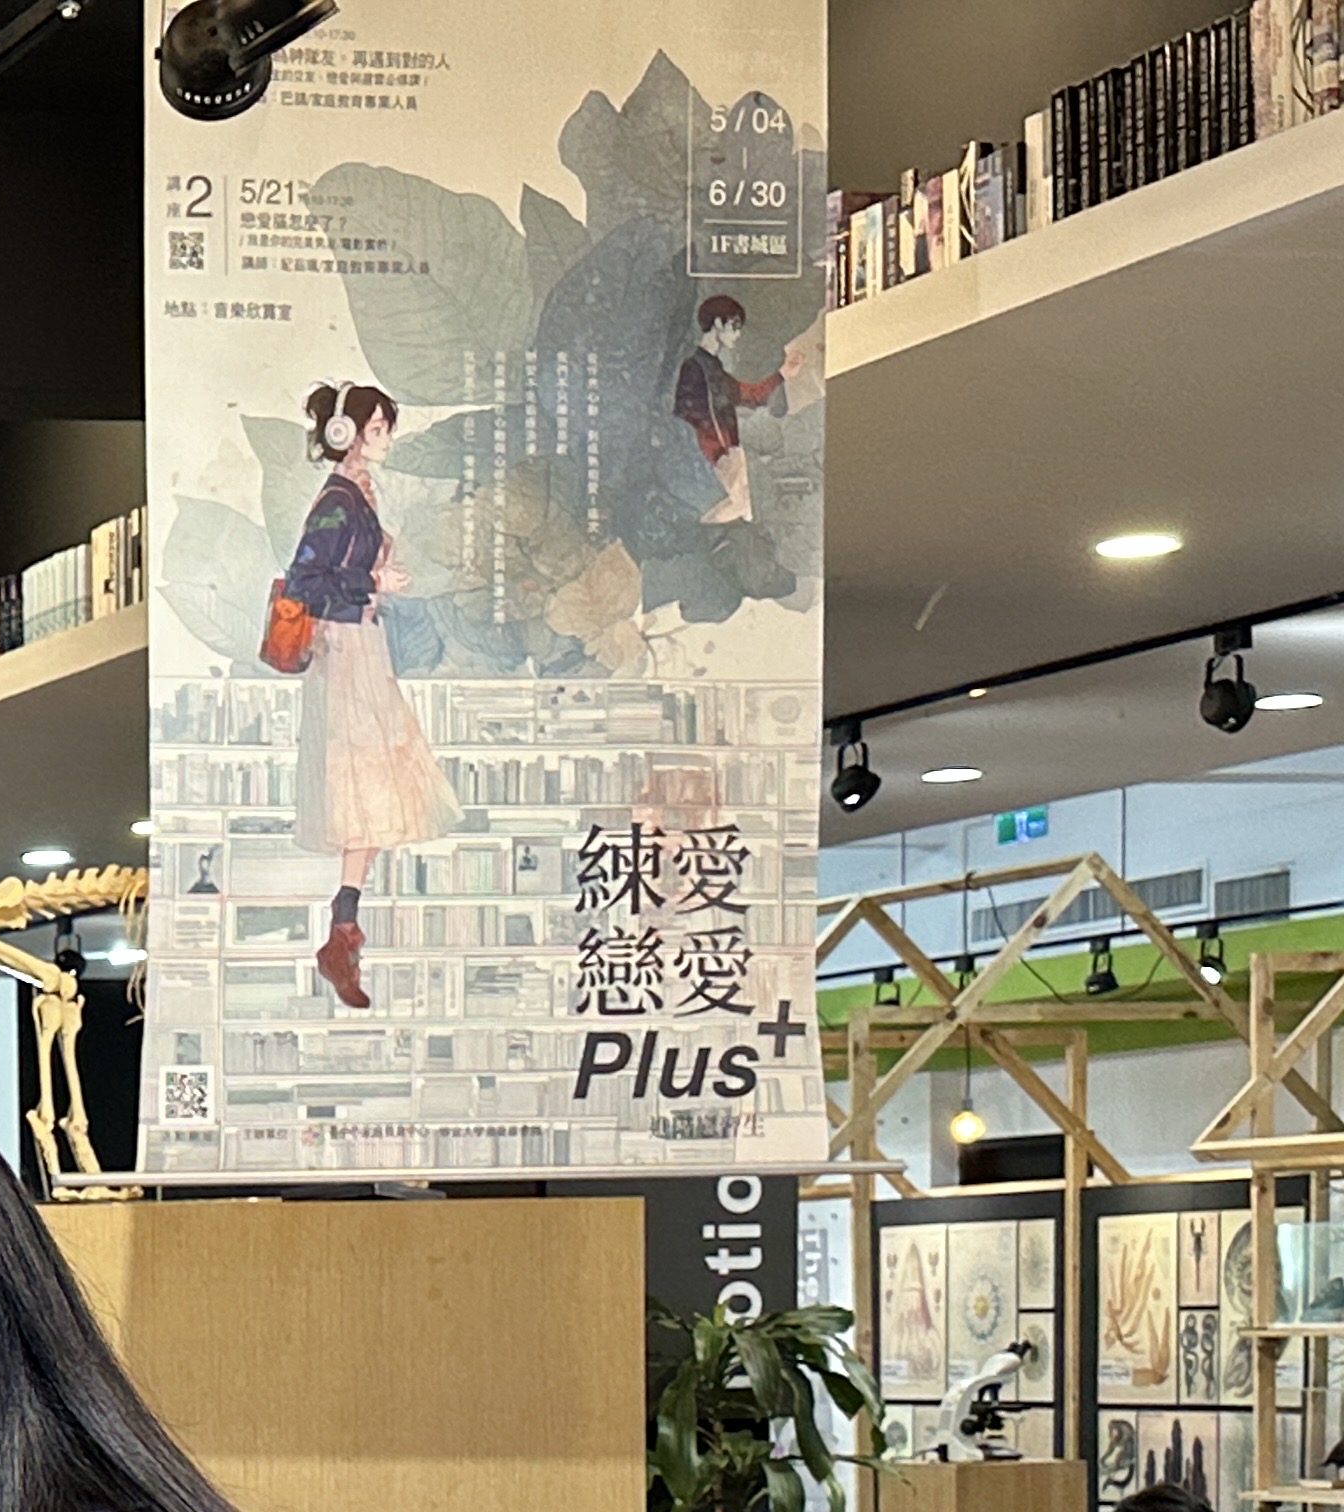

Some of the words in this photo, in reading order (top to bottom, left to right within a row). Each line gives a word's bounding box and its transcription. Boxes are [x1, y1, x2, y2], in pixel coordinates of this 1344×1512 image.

[710, 107, 786, 134] 5/04
[185, 175, 213, 218] 2
[240, 178, 296, 204] 5/21
[708, 180, 786, 207] 6/30
[711, 234, 787, 255] 1F書城區
[575, 822, 753, 916] 練愛
[576, 926, 757, 1018] 戀愛
